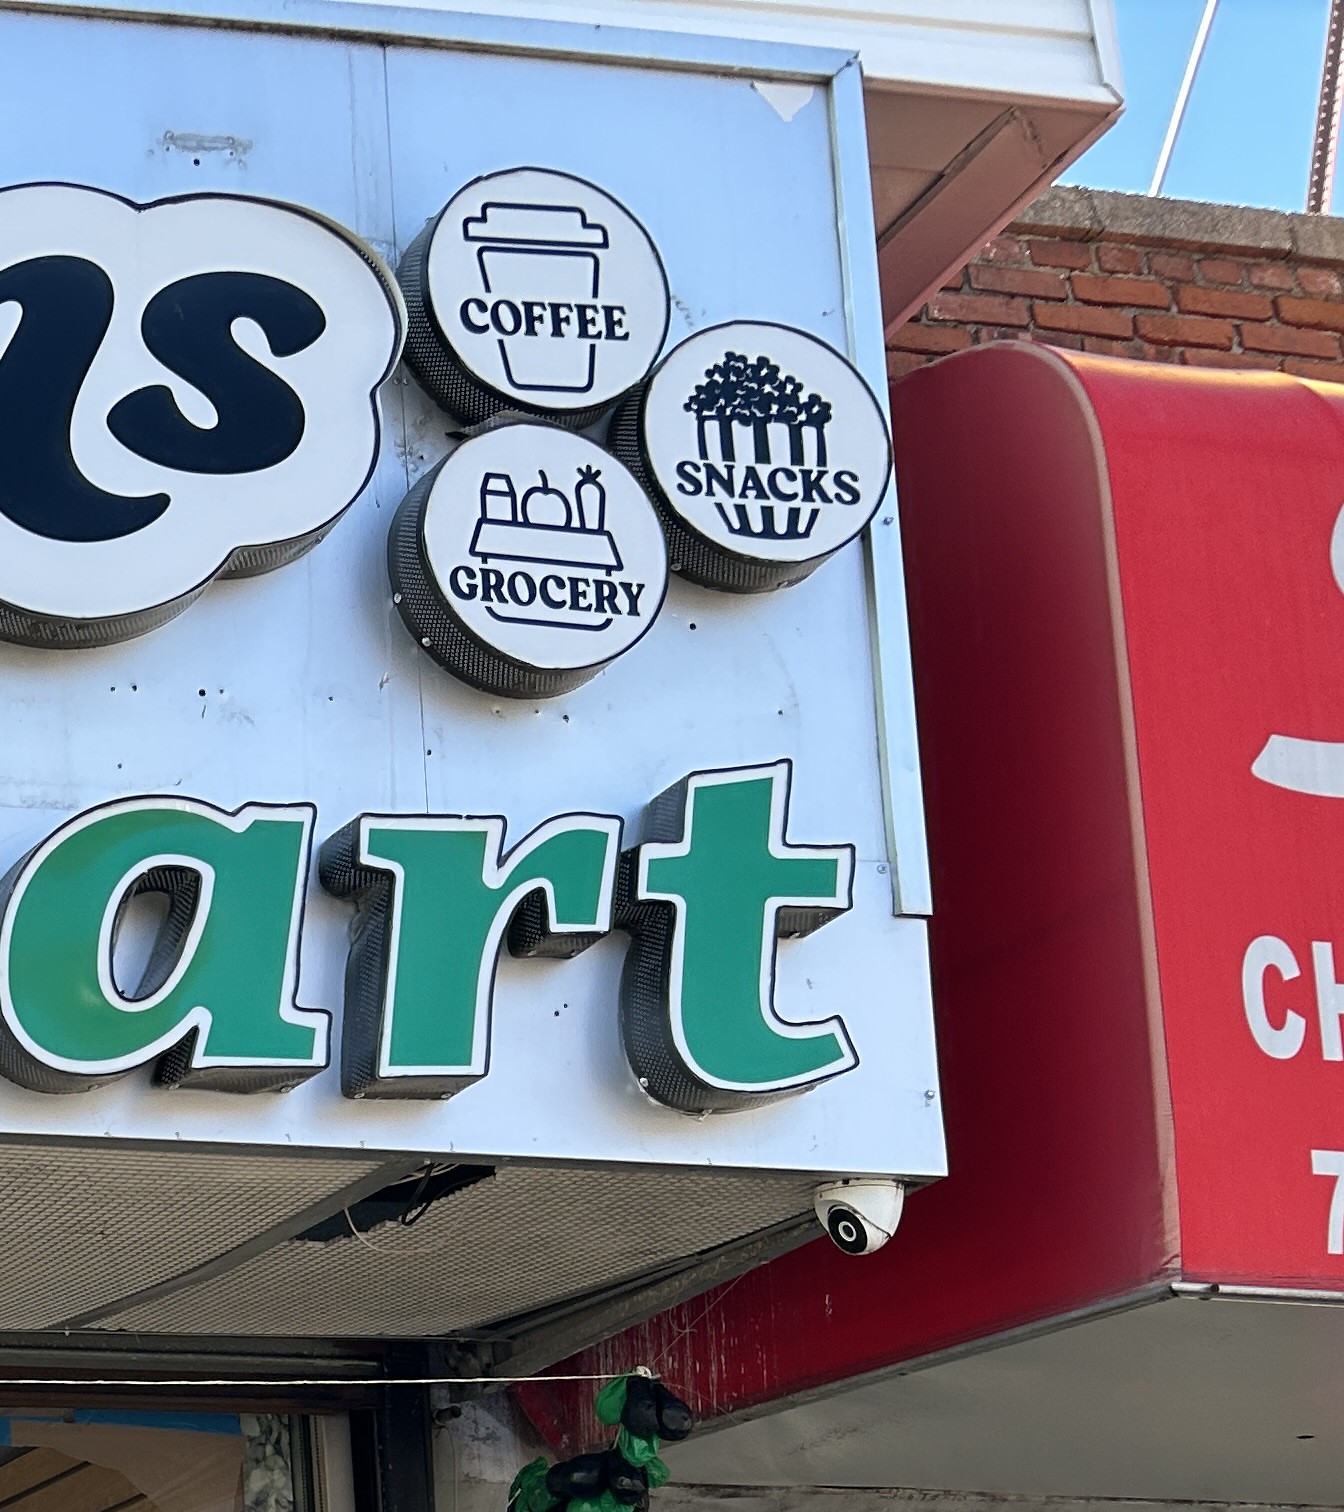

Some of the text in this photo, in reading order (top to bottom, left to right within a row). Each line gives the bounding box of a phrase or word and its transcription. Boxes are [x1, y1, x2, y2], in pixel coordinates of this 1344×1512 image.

[459, 297, 630, 342] COFFEE
[676, 460, 861, 506] SNACKS
[449, 565, 645, 618] GROCERY
